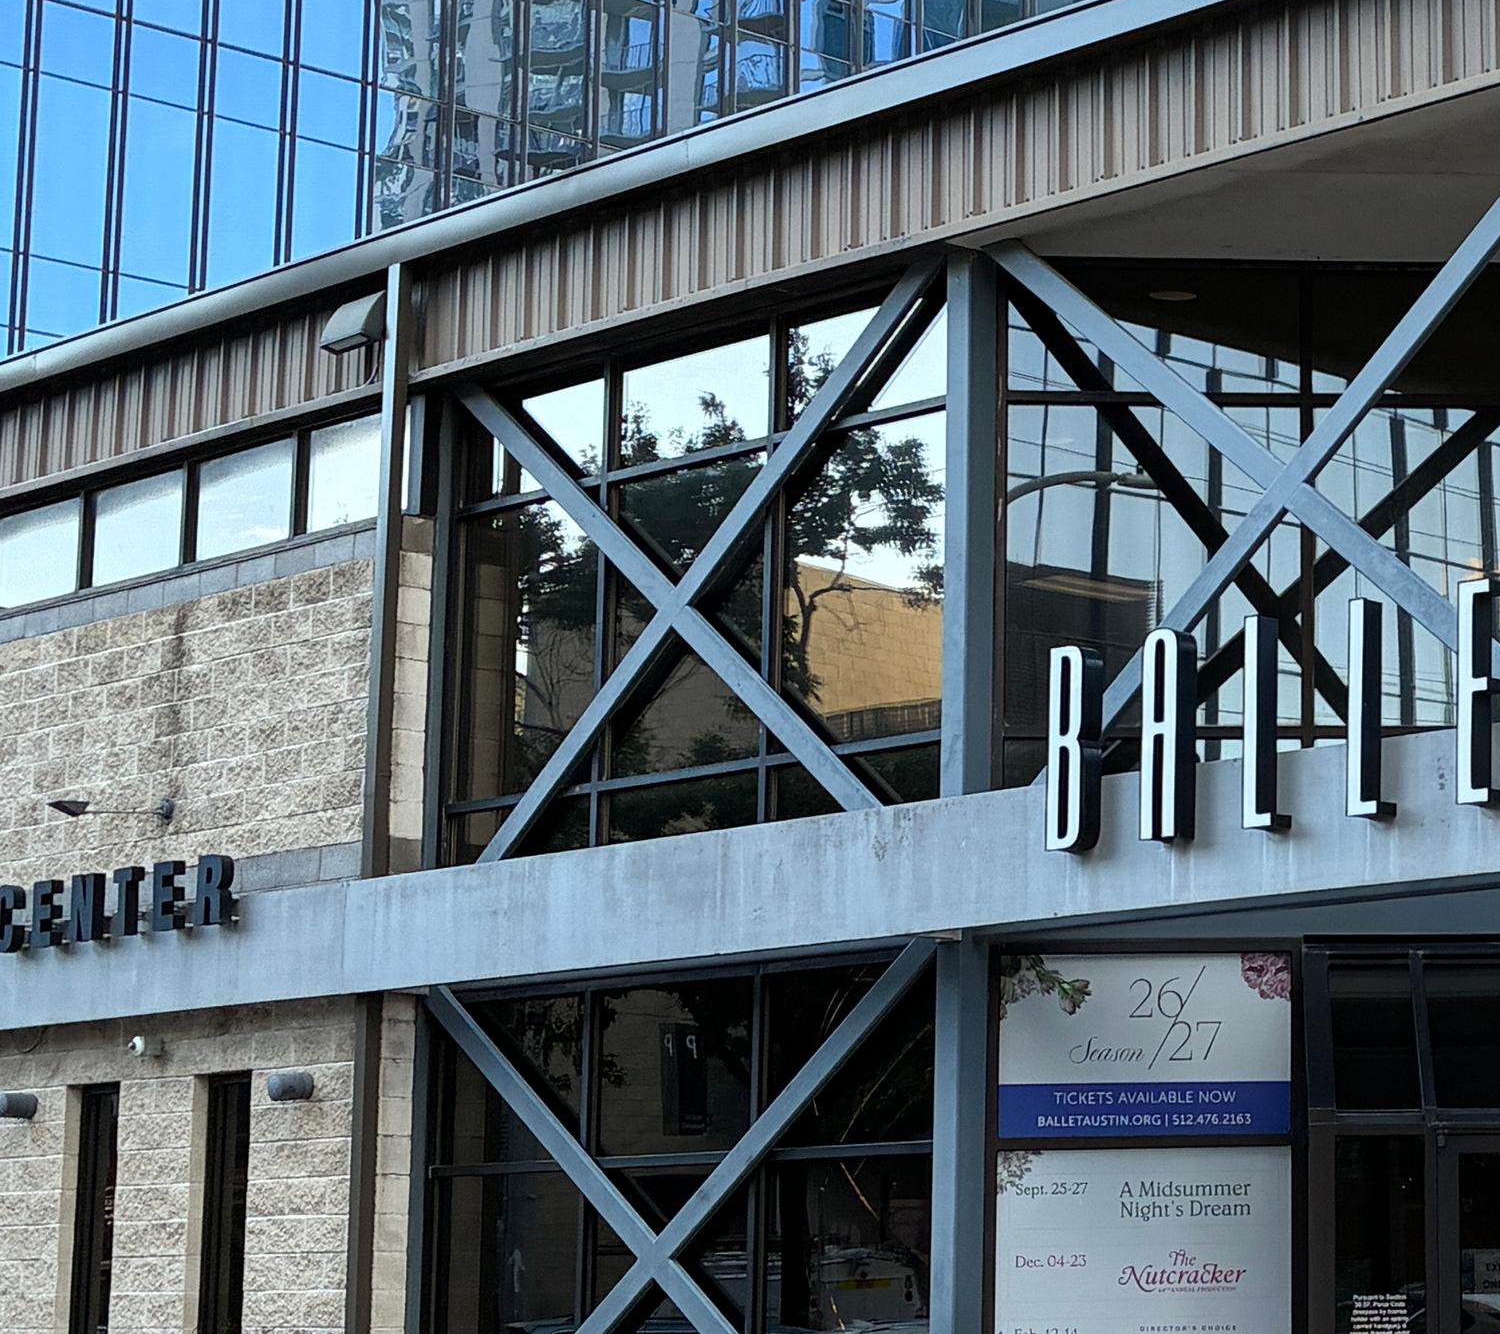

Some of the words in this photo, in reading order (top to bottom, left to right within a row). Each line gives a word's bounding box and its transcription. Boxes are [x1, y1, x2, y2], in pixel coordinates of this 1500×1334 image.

[0, 854, 235, 953] CENTER
[1069, 1036, 1144, 1064] Season
[1053, 1092, 1113, 1105] TICKETS
[1118, 1091, 1193, 1104] AVAILABLE
[1199, 1091, 1236, 1103] NOW
[1037, 1114, 1161, 1127] BALLETAUSTIN.ORG
[1173, 1113, 1252, 1126] 512.476.2163
[1015, 1183, 1048, 1199] Sept.
[1051, 1182, 1088, 1195] 25-27
[1120, 1181, 1134, 1197] A
[1139, 1181, 1251, 1197] Midsummer
[1120, 1201, 1184, 1221] Night's
[1190, 1200, 1251, 1217] Dream
[1015, 1255, 1044, 1268] Dec.
[1047, 1255, 1087, 1268] 04-23
[1168, 1249, 1197, 1266] The
[1118, 1263, 1247, 1292] Nutcracker
